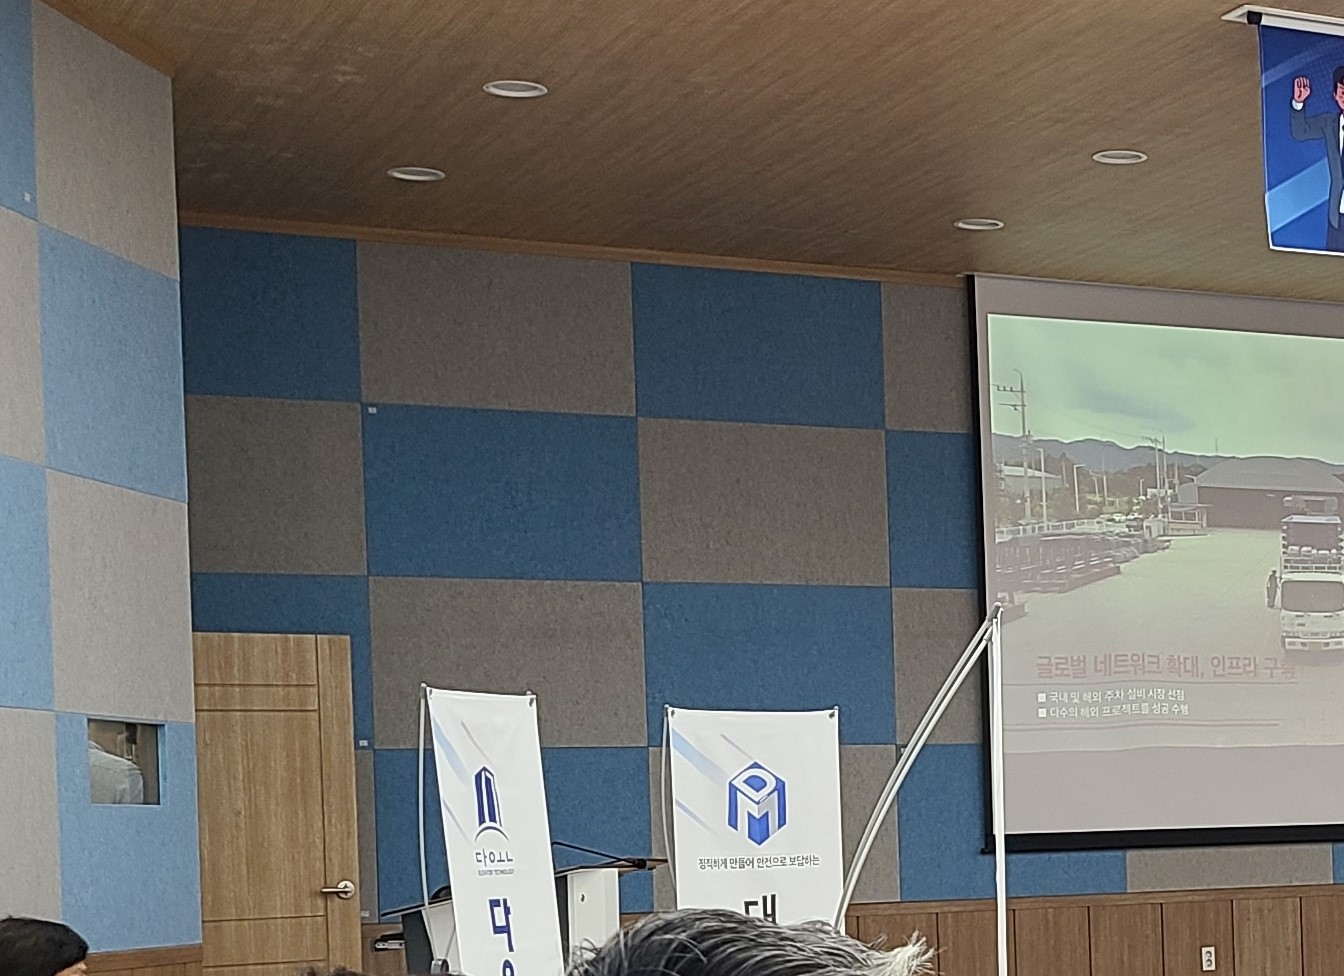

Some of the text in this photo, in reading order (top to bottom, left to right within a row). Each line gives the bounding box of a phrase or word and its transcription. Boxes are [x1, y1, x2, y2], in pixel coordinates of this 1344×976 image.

[1036, 654, 1088, 679] 글로벌
[1093, 652, 1162, 678] 네트워크
[1166, 654, 1205, 679] 확대,
[1209, 654, 1259, 678] 인프라
[1104, 689, 1125, 701] 주차
[756, 856, 788, 869] 안전으로
